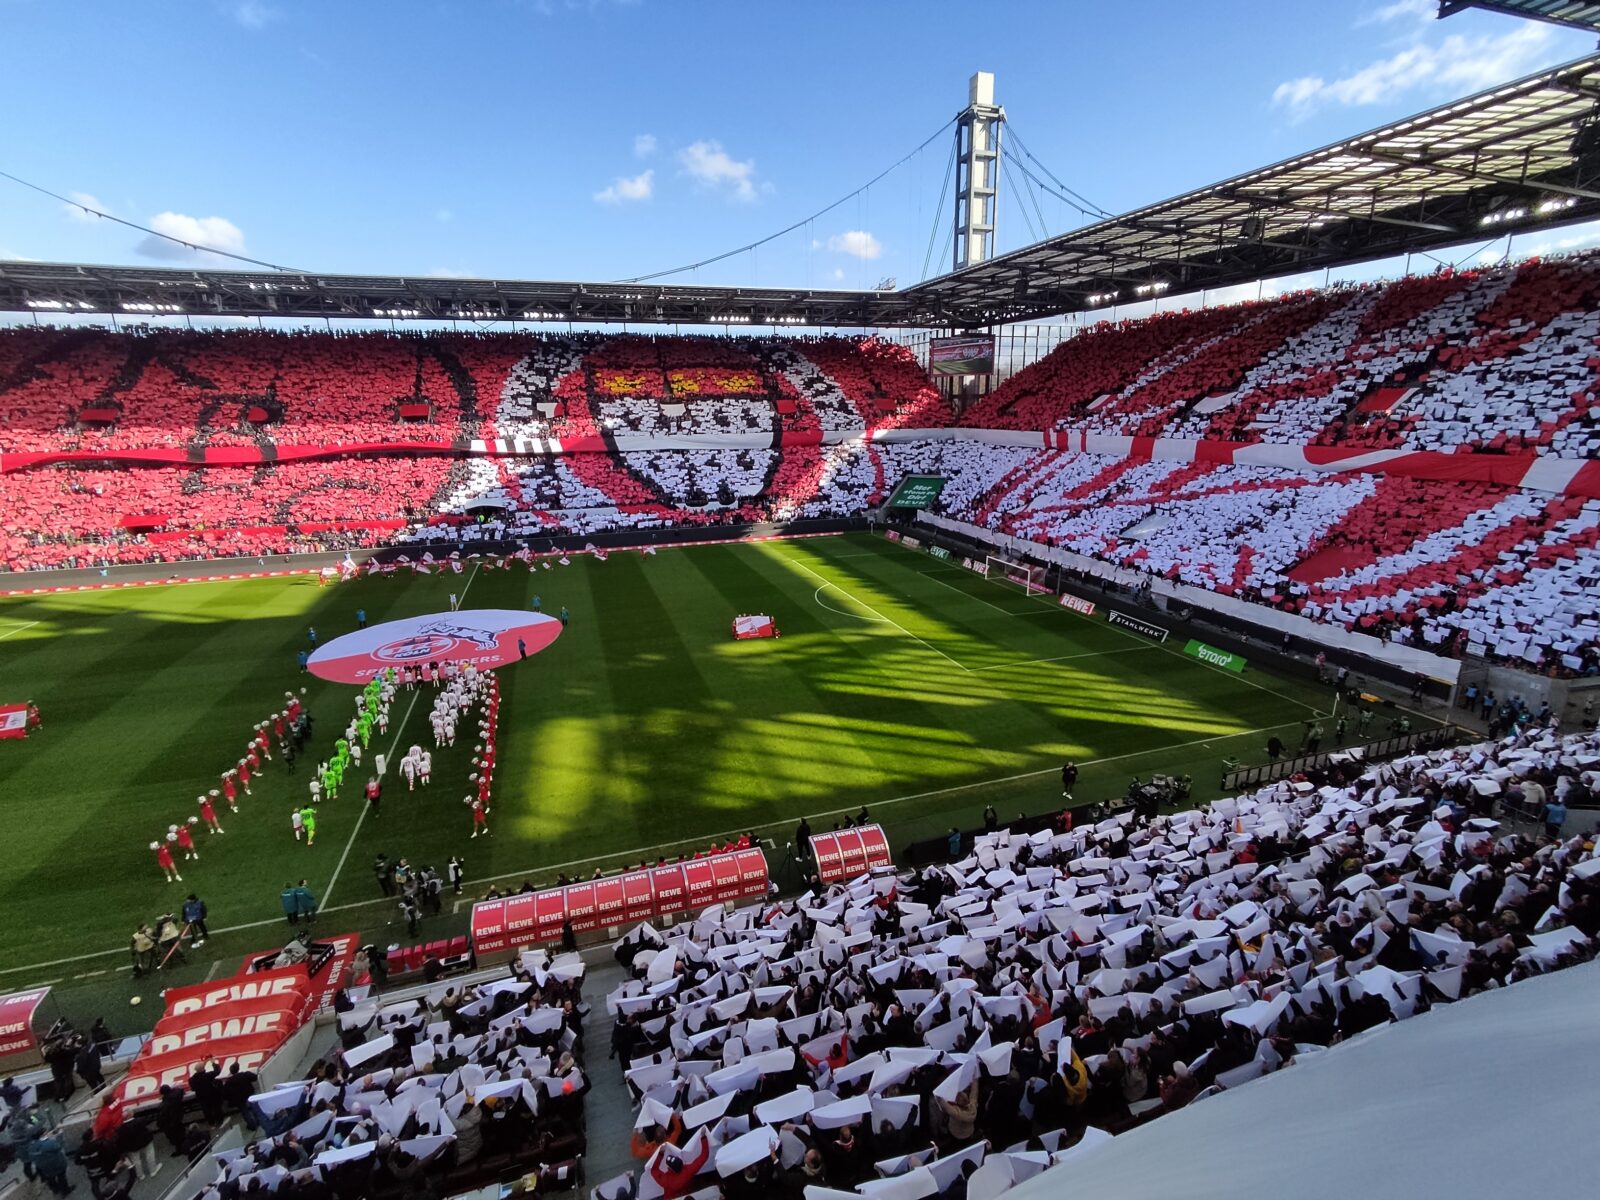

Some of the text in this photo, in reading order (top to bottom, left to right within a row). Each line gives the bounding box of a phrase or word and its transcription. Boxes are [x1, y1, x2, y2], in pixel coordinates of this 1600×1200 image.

[1060, 595, 1089, 614] REWE
[1116, 617, 1159, 637] STAHLWERK
[859, 825, 878, 833] REWE
[813, 834, 833, 842] REWE
[843, 848, 863, 858] REWE
[866, 843, 886, 853] REWE
[712, 856, 733, 864] REWE
[738, 851, 759, 859] REWE
[820, 852, 840, 862] REWE
[686, 862, 708, 870] REWE
[846, 863, 865, 873] REWE
[656, 867, 678, 876] REWE
[744, 869, 765, 880] REWE
[823, 868, 842, 878] REWE
[625, 873, 648, 882] REWE
[717, 875, 738, 886] REWE
[597, 879, 620, 888] REWE
[690, 880, 712, 891] REWE
[744, 883, 765, 893] REWE
[568, 885, 592, 893] REWE
[659, 888, 682, 898] REWE
[718, 889, 739, 899] REWE
[539, 890, 562, 900] REWE
[627, 894, 650, 904] REWE
[691, 894, 713, 904] REWE
[509, 896, 532, 905] REWE
[599, 899, 622, 911] REWE
[478, 902, 503, 912] REWE
[660, 901, 682, 911] REWE
[570, 906, 594, 917] REWE
[629, 909, 651, 918] REWE
[539, 912, 563, 923] REWE
[600, 915, 624, 925] REWE
[508, 918, 533, 930] REWE
[571, 921, 595, 931] REWE
[476, 925, 502, 937] REWE
[510, 934, 535, 944] REWE
[478, 940, 504, 950] REWE
